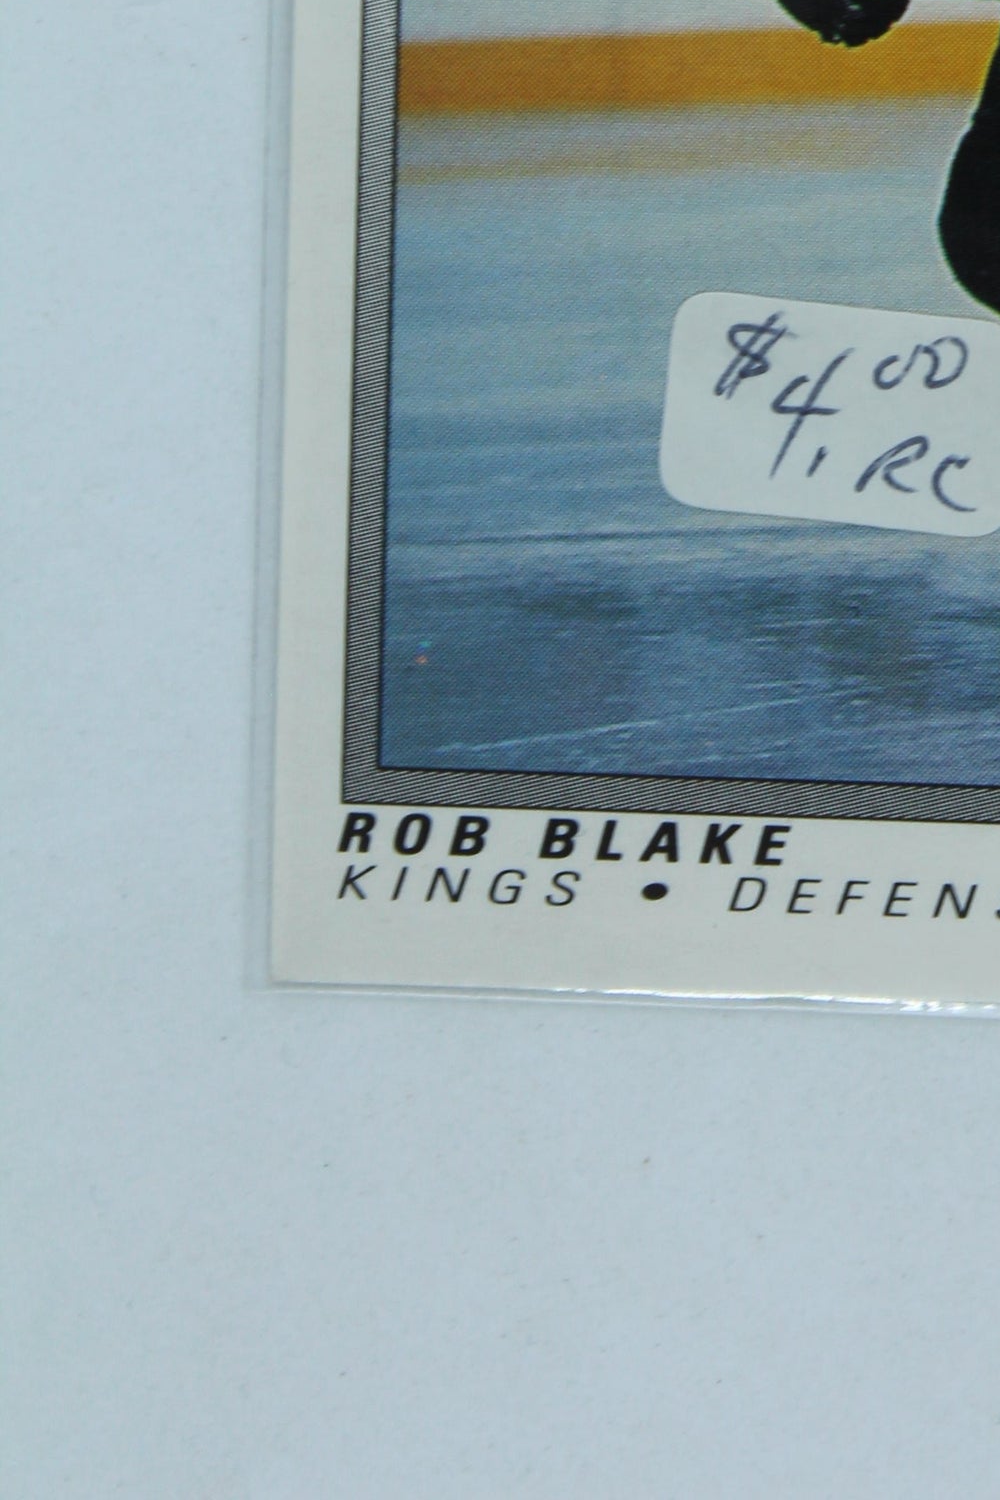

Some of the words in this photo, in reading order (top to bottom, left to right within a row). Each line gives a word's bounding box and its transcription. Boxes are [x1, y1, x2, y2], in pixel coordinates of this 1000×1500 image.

[854, 435, 978, 513] RC
[337, 811, 491, 857] ROB
[538, 818, 791, 866] BLAKE
[337, 863, 582, 907] KINGS
